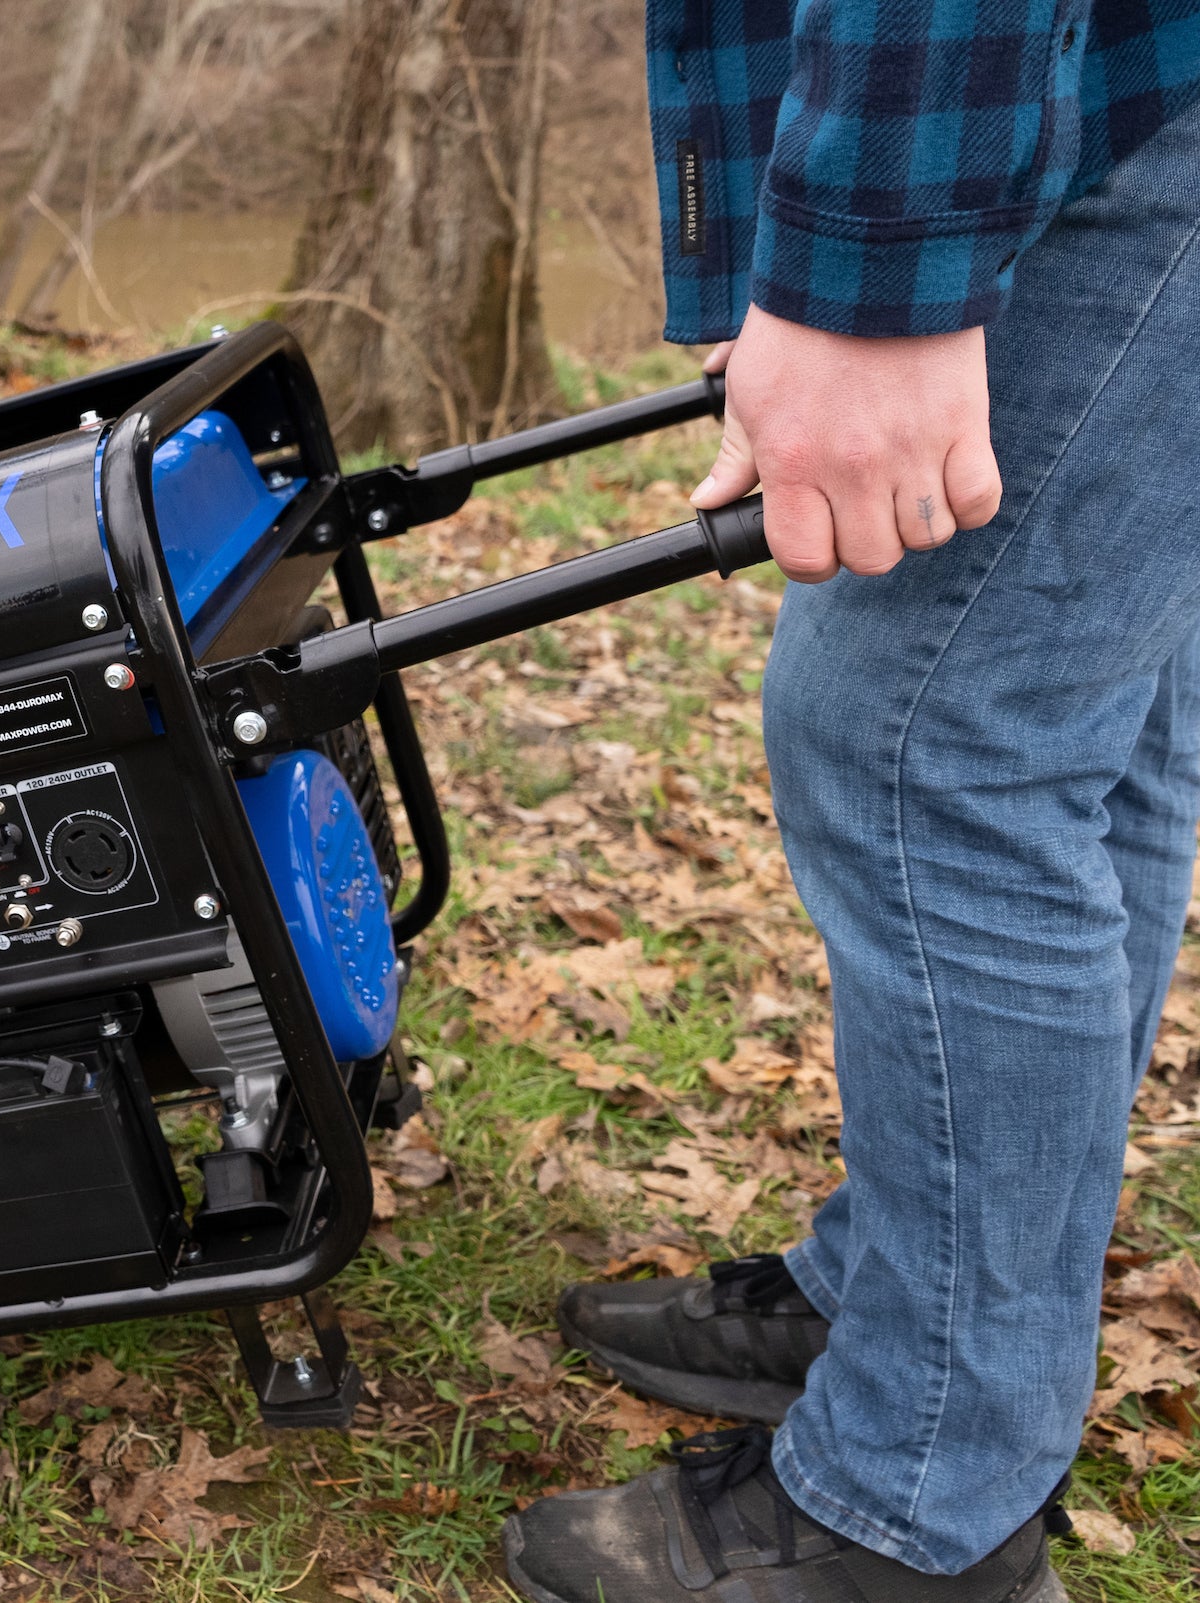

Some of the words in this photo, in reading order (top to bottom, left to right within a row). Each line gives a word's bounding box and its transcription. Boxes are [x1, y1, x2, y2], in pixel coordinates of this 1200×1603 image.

[686, 154, 696, 181] FREE
[687, 185, 697, 242] ASSEMBLY
[26, 772, 72, 790] 120/240V
[74, 764, 108, 779] OUTLET
[86, 809, 112, 820] AC120V
[45, 831, 55, 855] AC120V
[107, 878, 128, 894] AC240V
[31, 935, 52, 944] FRAME
